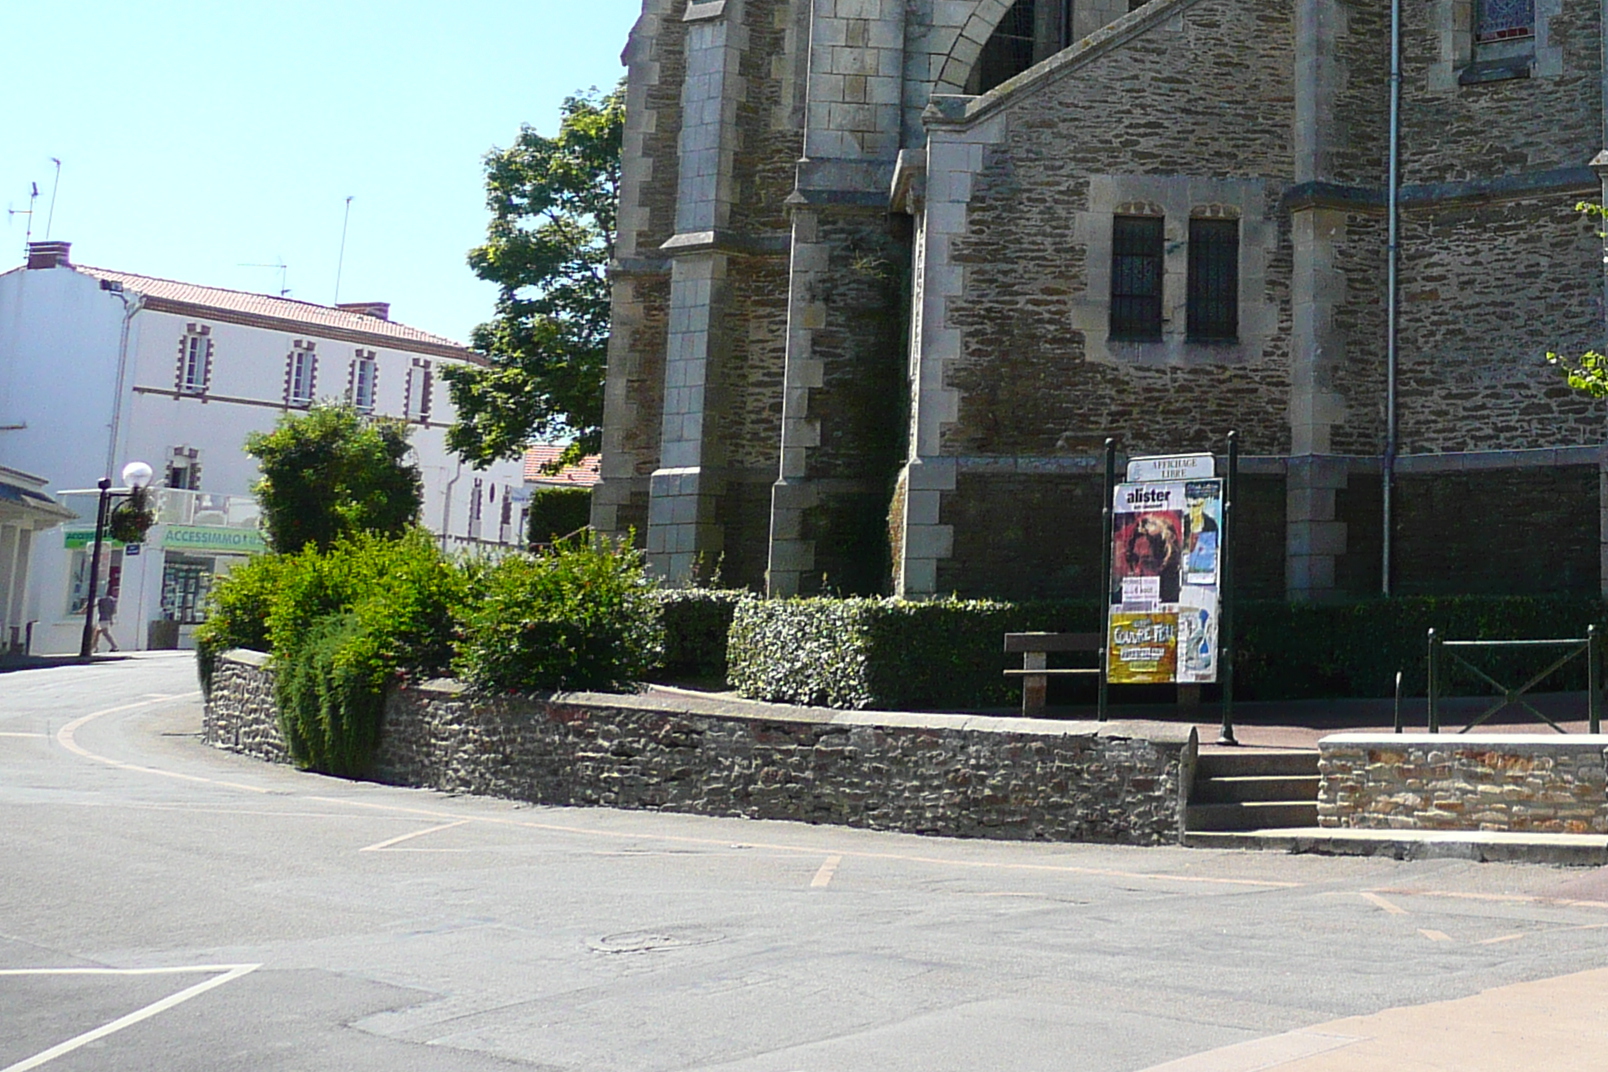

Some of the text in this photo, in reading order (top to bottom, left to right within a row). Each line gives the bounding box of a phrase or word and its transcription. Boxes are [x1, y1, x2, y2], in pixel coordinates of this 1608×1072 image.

[1152, 458, 1198, 469] AFFICHAGE
[1161, 469, 1187, 479] LIBRE
[1126, 487, 1172, 504] alister
[165, 530, 242, 545] ACCESSIMMO
